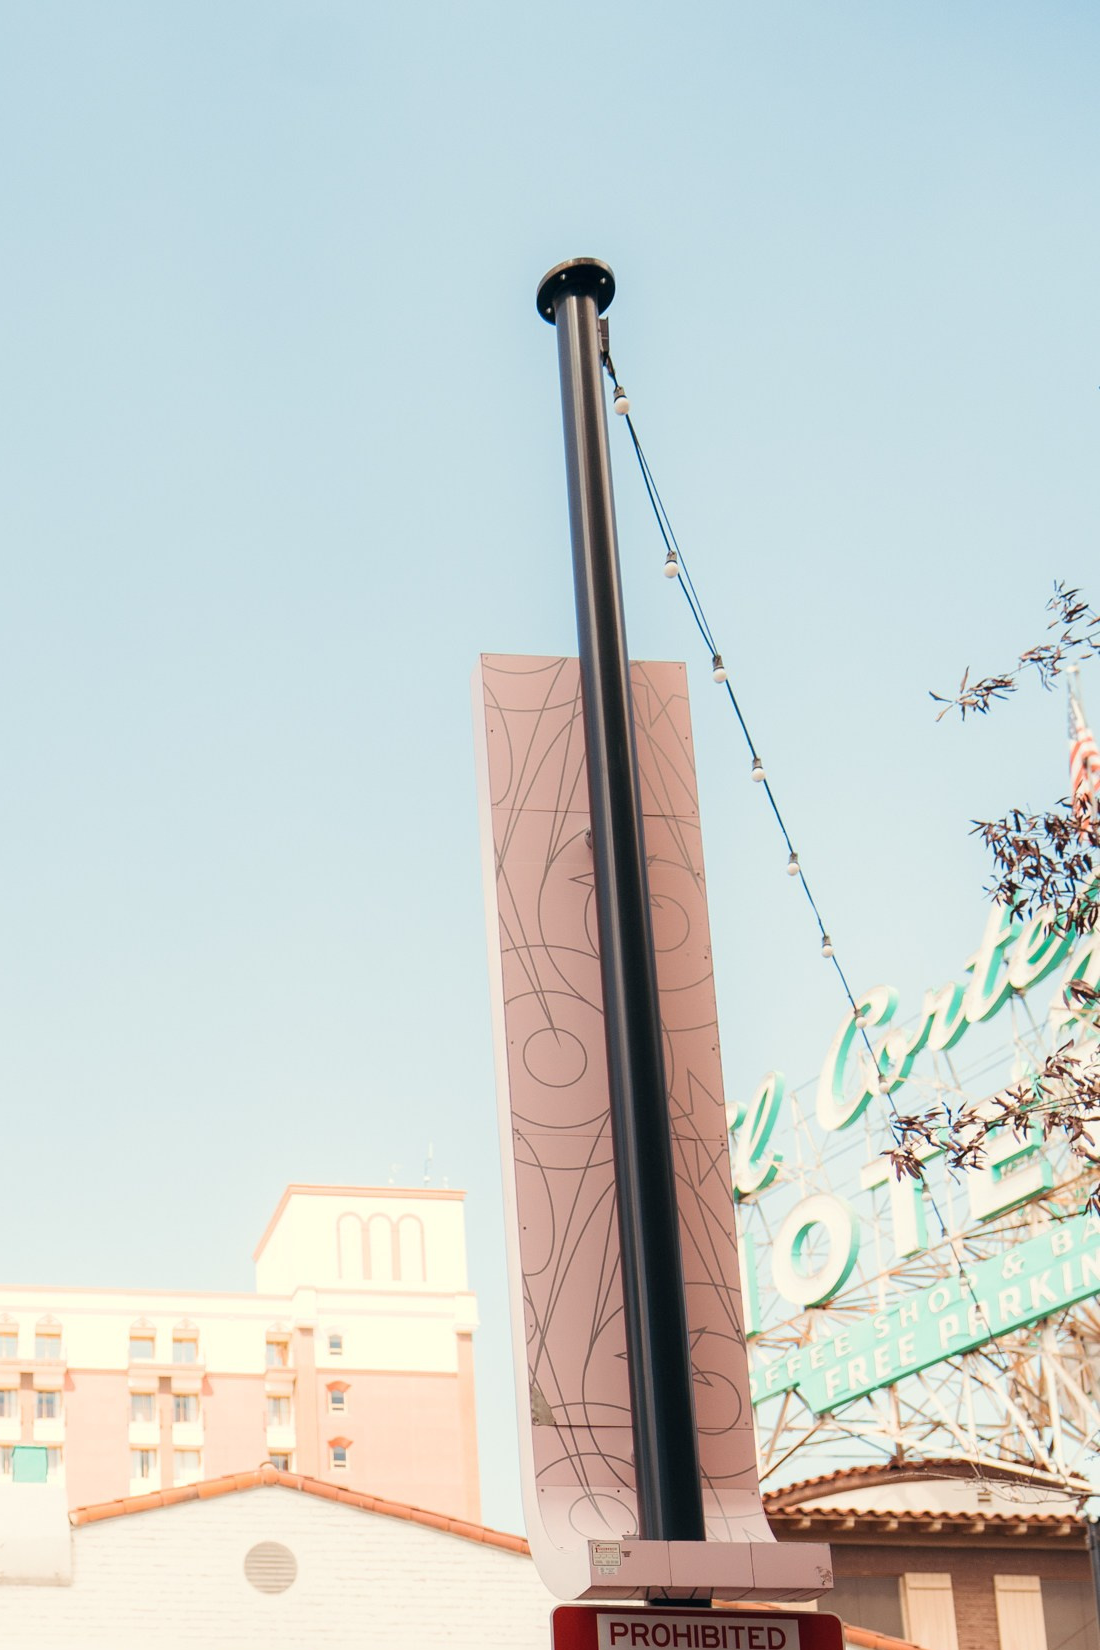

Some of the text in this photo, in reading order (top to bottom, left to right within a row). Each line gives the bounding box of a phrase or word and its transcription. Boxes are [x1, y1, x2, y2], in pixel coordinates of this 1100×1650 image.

[750, 1332, 854, 1399] FFEE
[873, 1273, 979, 1340] SHOP
[1002, 1252, 1026, 1281] &
[824, 1332, 918, 1401] FREE
[609, 1622, 787, 1650] PROHIBITED
